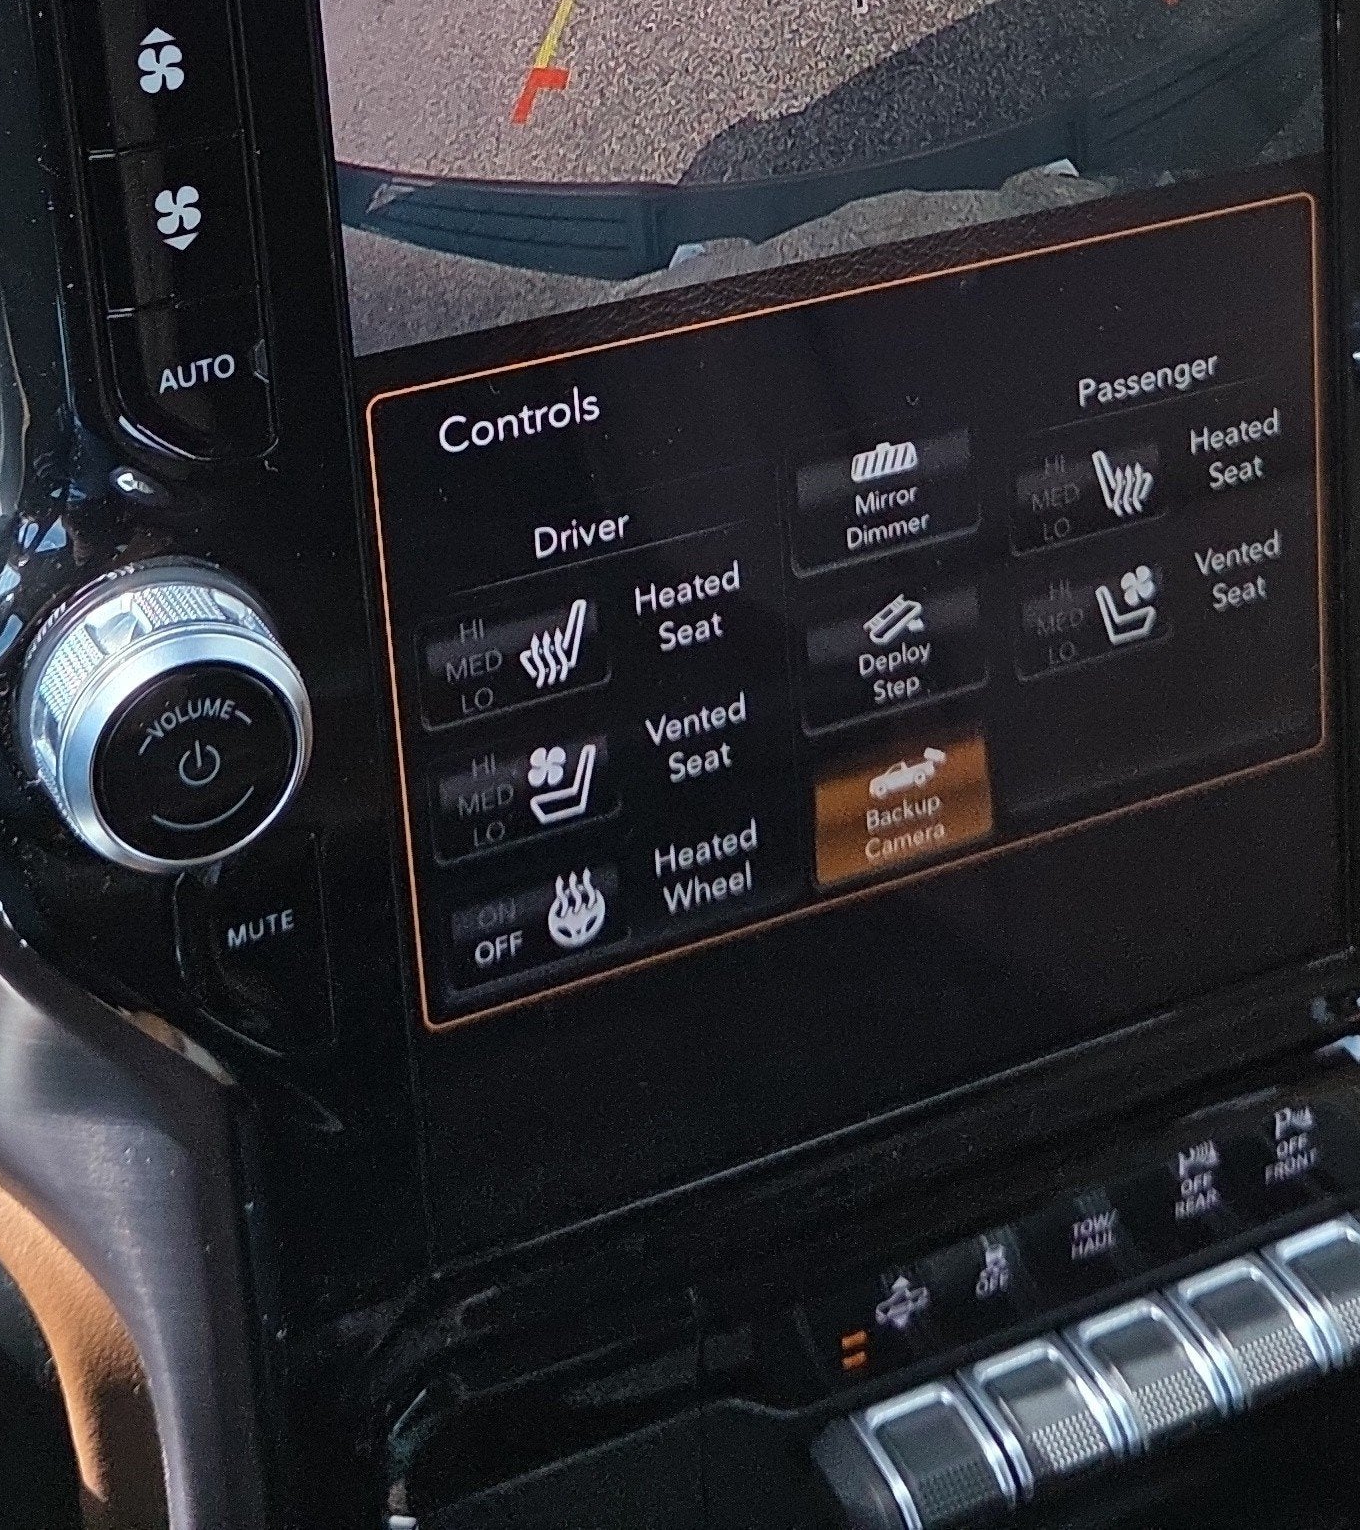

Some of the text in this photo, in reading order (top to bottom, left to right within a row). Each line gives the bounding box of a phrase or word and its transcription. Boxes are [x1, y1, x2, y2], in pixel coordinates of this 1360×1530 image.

[159, 354, 235, 393] AUTO
[1079, 355, 1218, 408] Passenger
[439, 387, 600, 452] Controls
[1190, 409, 1281, 455] Heated
[1209, 455, 1264, 490] Seat
[854, 483, 917, 517] Mirror
[535, 514, 629, 559] Driver
[846, 513, 930, 550] Dimmer
[1195, 530, 1282, 575] Vented
[635, 561, 741, 615] Heated
[1212, 576, 1267, 612] Seat
[459, 618, 485, 645] HI
[659, 612, 724, 652] Seat
[445, 649, 502, 683] MED
[858, 641, 931, 676] Deploy
[460, 687, 494, 714] LO
[873, 674, 920, 704] Step
[147, 698, 236, 739] VOLUME
[645, 691, 746, 746] Vented
[669, 742, 733, 782] Seat
[458, 783, 515, 817] MED
[866, 793, 941, 832] Backup
[472, 821, 506, 847] LO
[654, 818, 758, 878] Heated
[865, 824, 946, 861] Camera
[663, 862, 753, 914] Wheel
[227, 909, 295, 948] MUTE
[474, 930, 523, 967] OFF
[1265, 1147, 1318, 1185] FRONT
[1071, 1231, 1115, 1260] HAUL
